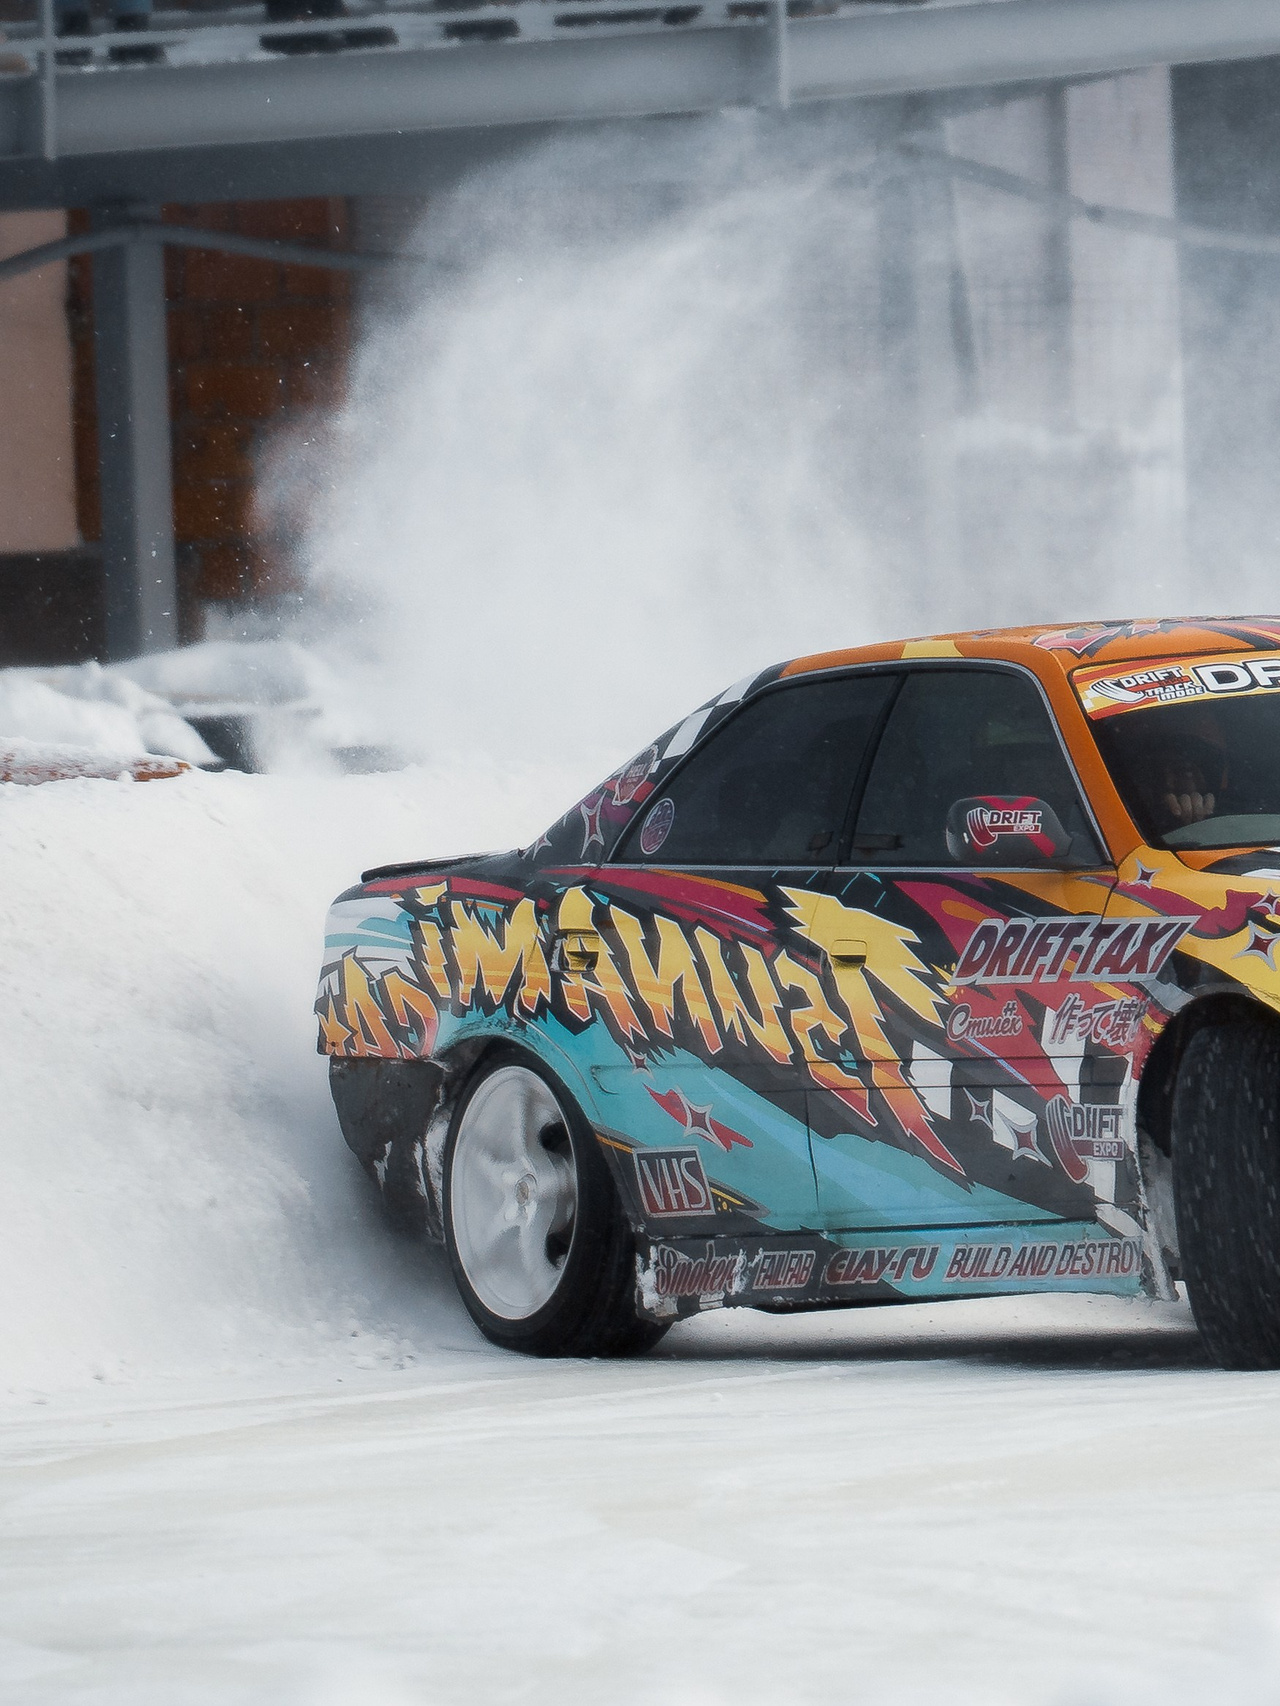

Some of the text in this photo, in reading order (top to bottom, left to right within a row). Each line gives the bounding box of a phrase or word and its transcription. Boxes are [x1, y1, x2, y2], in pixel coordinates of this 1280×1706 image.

[1120, 666, 1182, 688] DRIFT
[1145, 681, 1195, 697] TRACK
[988, 810, 1041, 825] DRIFT
[1013, 824, 1035, 832] EXPO
[956, 921, 1192, 979] DRIFT TAXI
[1093, 1142, 1119, 1157] EXPO
[641, 1156, 707, 1211] VHS
[946, 1246, 1011, 1278] BUILD
[1008, 1245, 1058, 1277] AND
